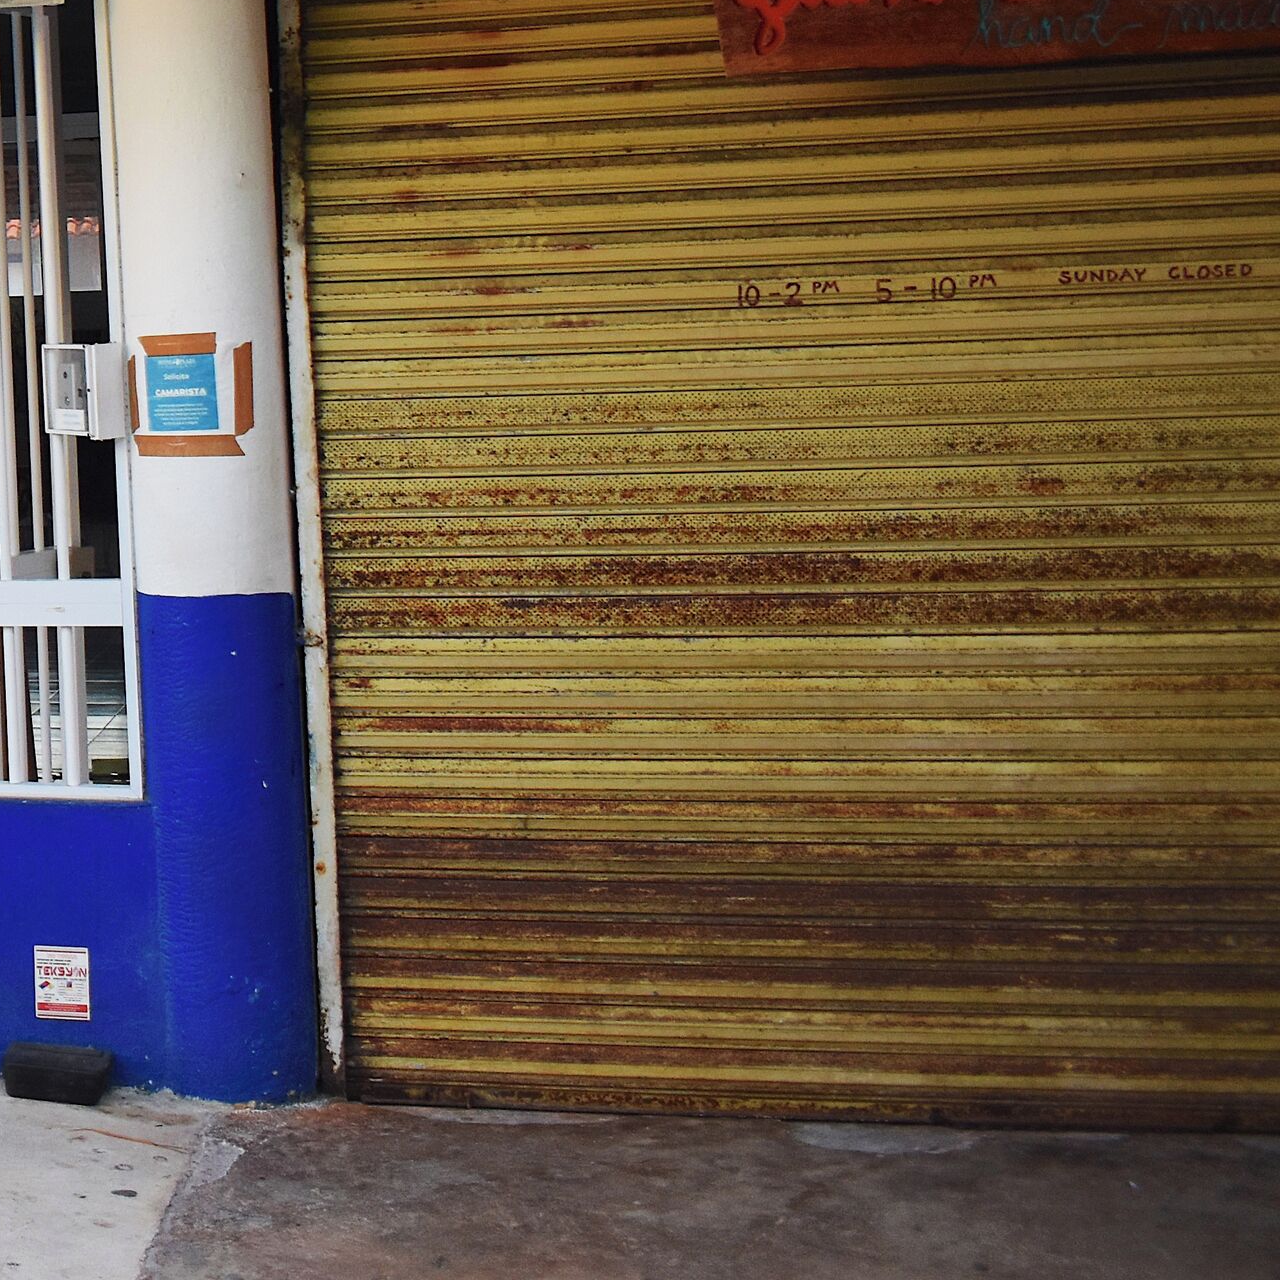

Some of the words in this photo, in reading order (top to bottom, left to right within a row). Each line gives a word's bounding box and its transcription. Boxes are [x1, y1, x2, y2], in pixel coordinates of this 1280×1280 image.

[1058, 267, 1147, 285] SUNDAY
[1168, 263, 1253, 280] CLOSED
[155, 387, 207, 398] CAMARISTA
